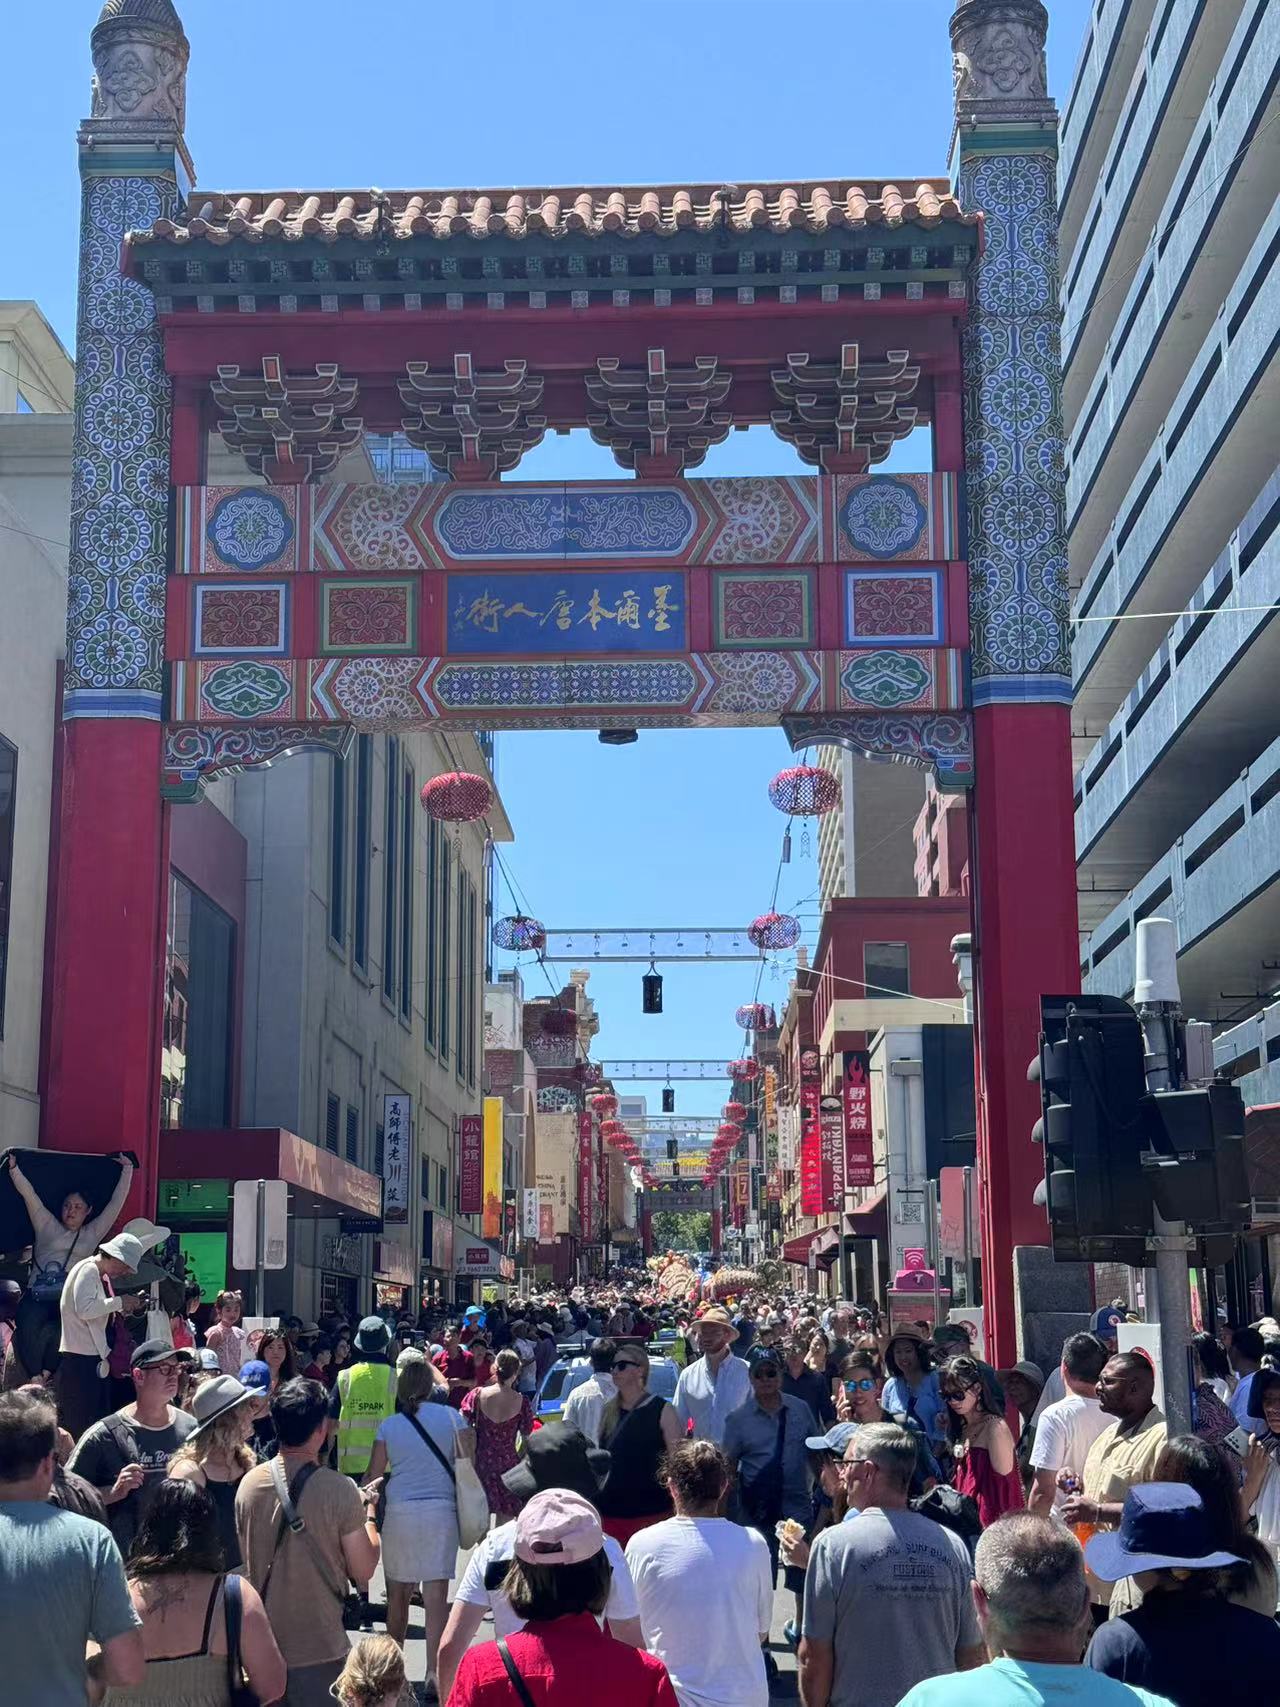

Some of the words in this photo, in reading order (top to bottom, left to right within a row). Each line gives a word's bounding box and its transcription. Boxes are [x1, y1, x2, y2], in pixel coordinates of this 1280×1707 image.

[466, 584, 679, 633] 墨爾本唐人街
[463, 1162, 472, 1199] STREET
[358, 1401, 385, 1411] SPARK
